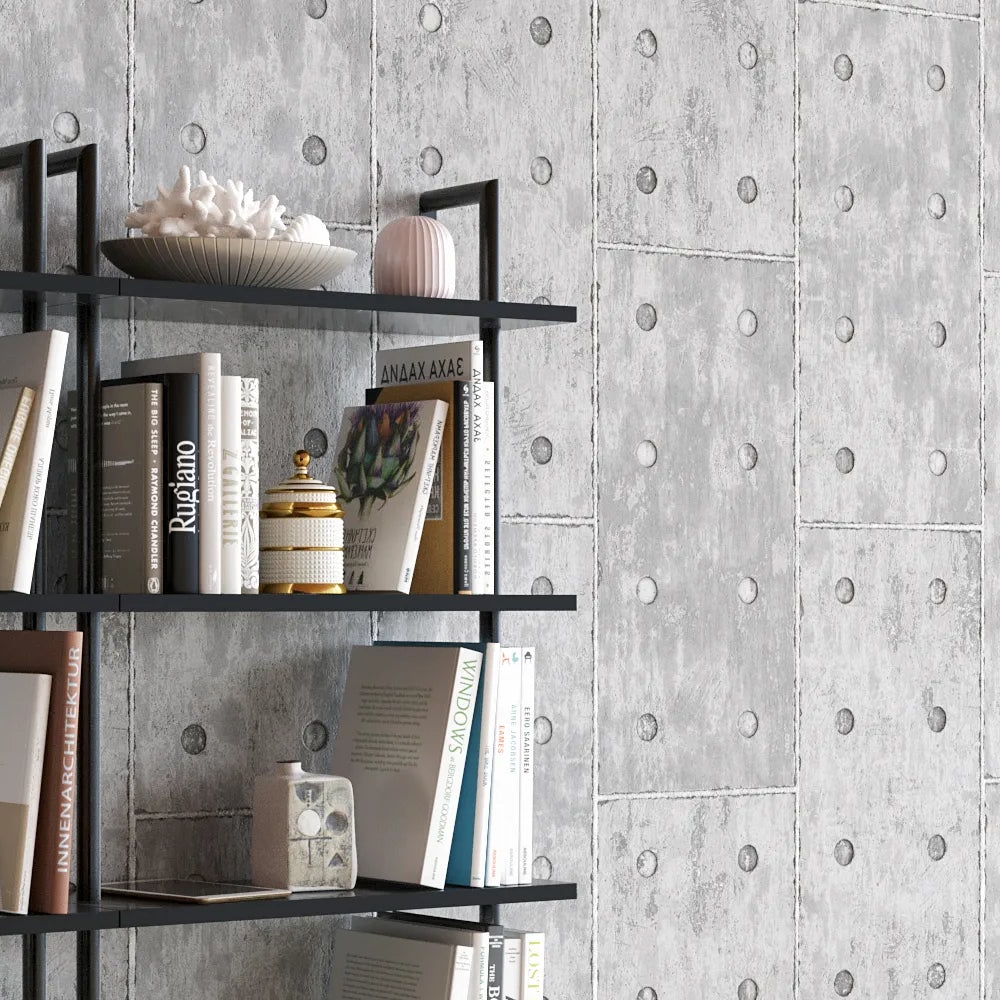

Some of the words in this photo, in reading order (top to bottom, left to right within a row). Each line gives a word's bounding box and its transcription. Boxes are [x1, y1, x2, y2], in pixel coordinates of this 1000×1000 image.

[168, 440, 200, 534] Rugiano
[206, 438, 215, 502] Revolution
[223, 466, 238, 548] GALLERIE
[448, 659, 478, 755] WINDOWS
[497, 725, 505, 754] EAMES
[56, 647, 81, 873] INNENARCHITEKTUR
[488, 963, 496, 983] THE
